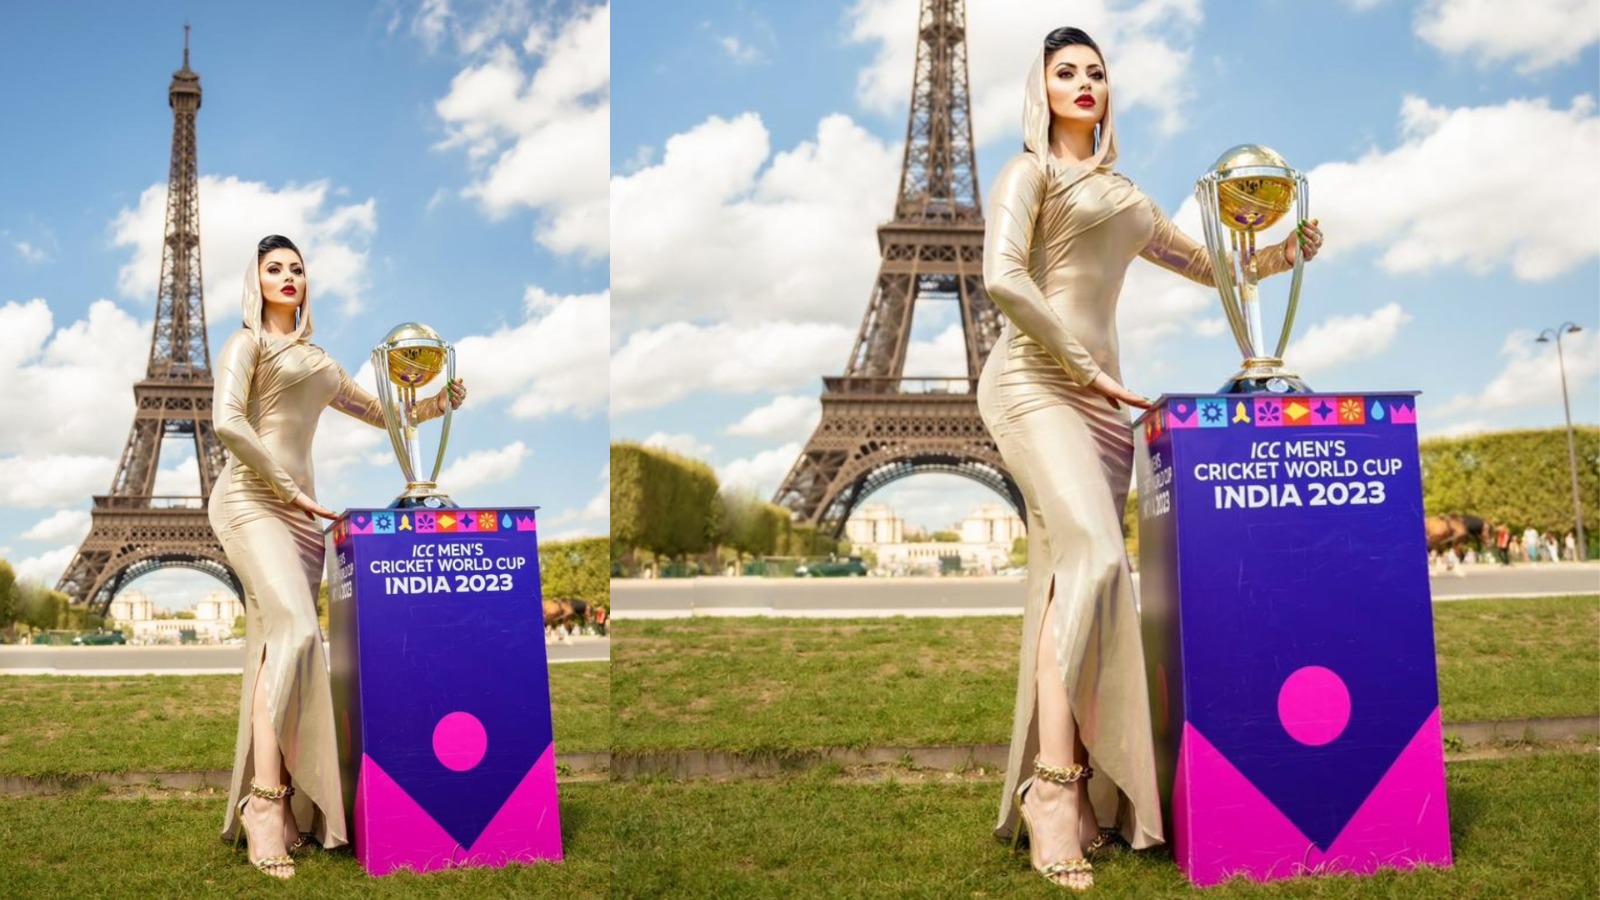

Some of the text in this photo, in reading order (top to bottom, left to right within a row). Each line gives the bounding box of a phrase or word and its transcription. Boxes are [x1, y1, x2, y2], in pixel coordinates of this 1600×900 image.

[1250, 439, 1347, 459] ICC MEN'S
[1194, 458, 1403, 482] CRICKET WORLD CUP
[1214, 480, 1386, 509] INDIA 2023
[412, 542, 484, 558] ICC MEN'S
[369, 556, 526, 574] CRICKET WORLD CUP
[385, 573, 514, 595] INDIA 2023
